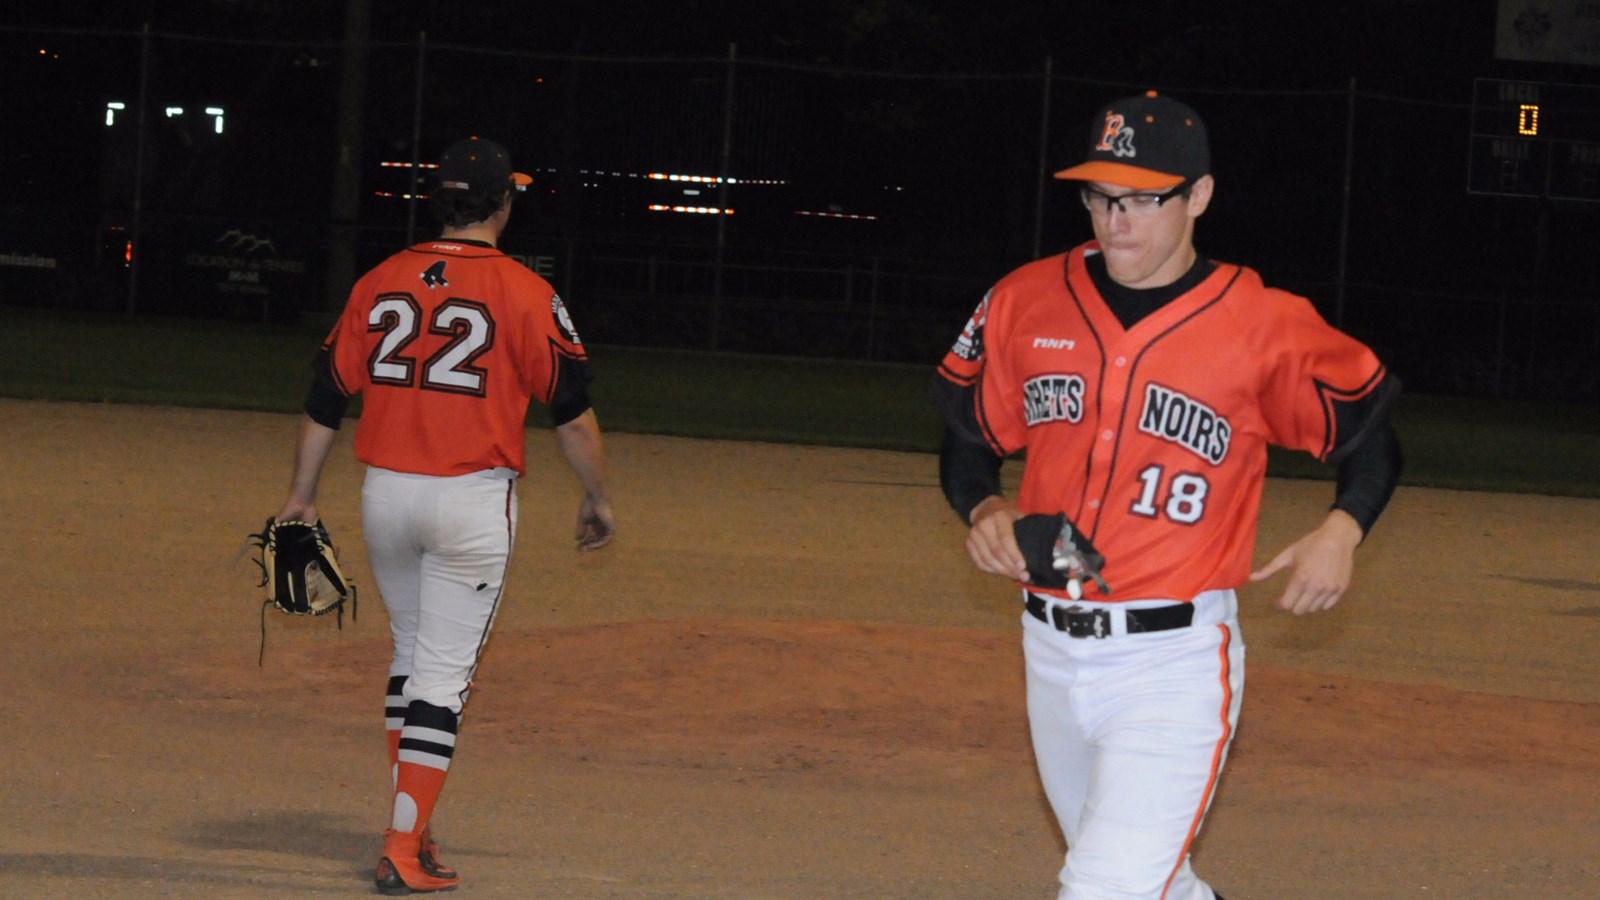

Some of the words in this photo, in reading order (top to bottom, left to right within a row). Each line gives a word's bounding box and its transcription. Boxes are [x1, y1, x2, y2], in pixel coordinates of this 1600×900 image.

[1518, 103, 1540, 136] 0
[367, 293, 495, 397] 22
[1139, 384, 1231, 464] NOIRS
[1130, 465, 1210, 524] 18
